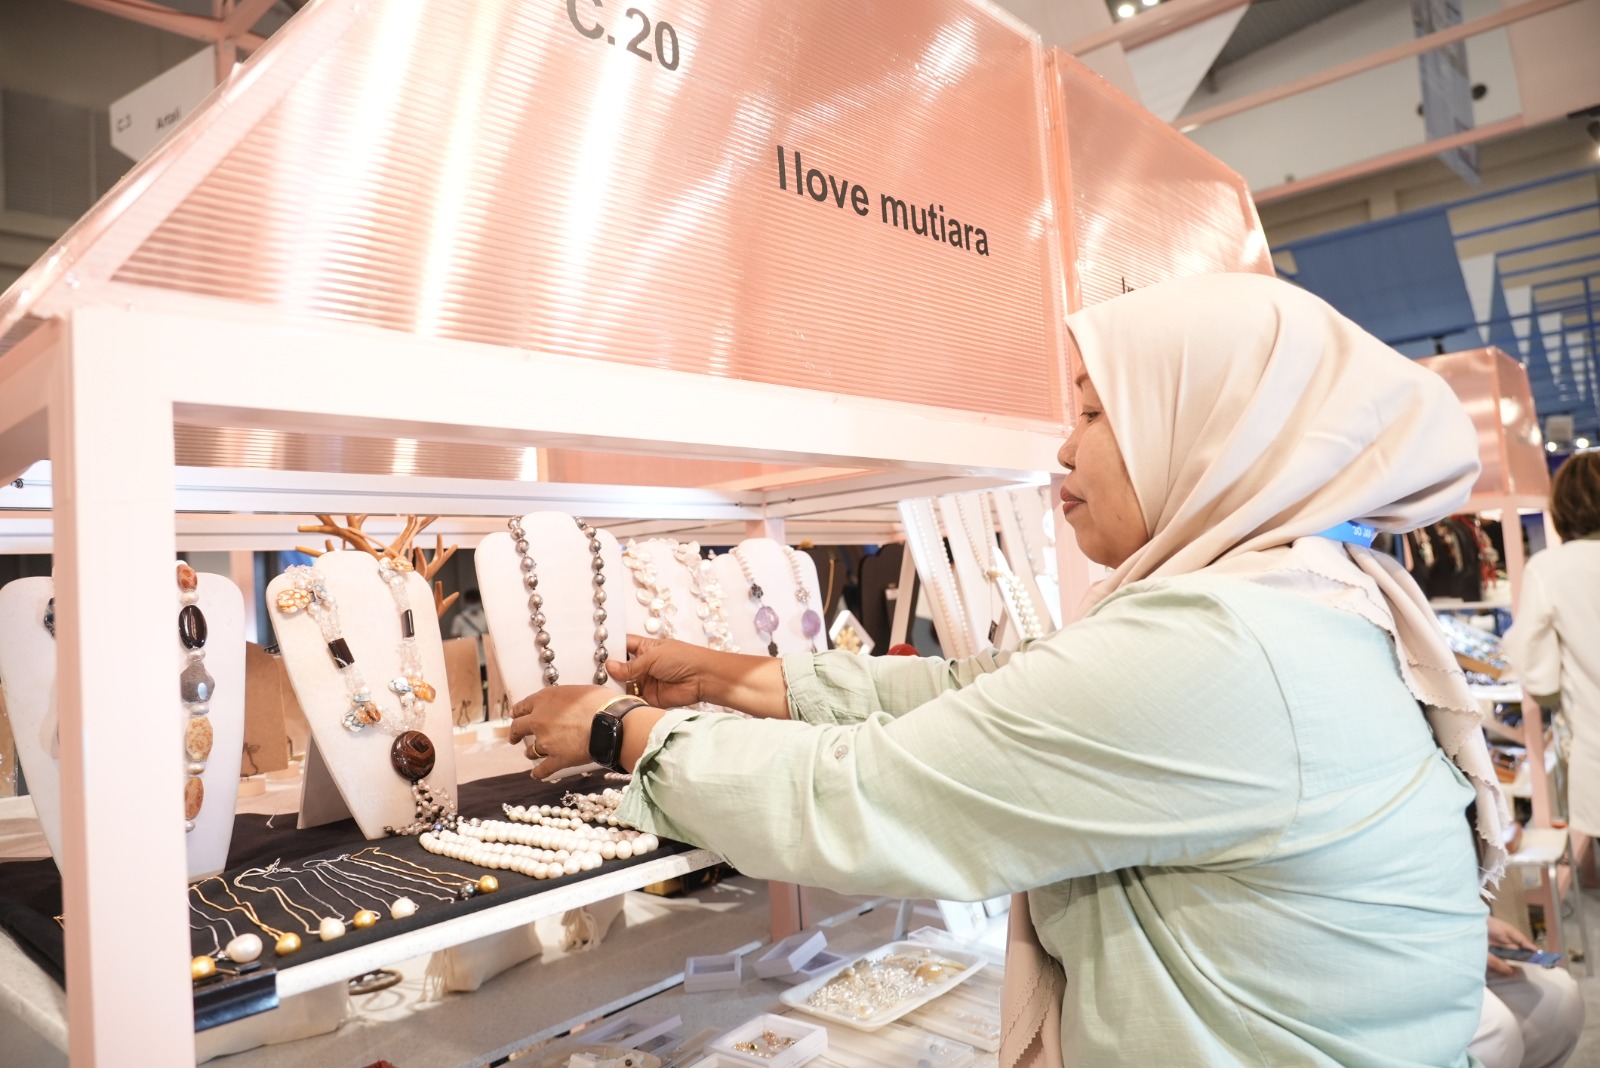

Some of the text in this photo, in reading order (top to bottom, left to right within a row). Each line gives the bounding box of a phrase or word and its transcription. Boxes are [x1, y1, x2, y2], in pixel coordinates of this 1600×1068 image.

[777, 145, 990, 257] I love mutiara
